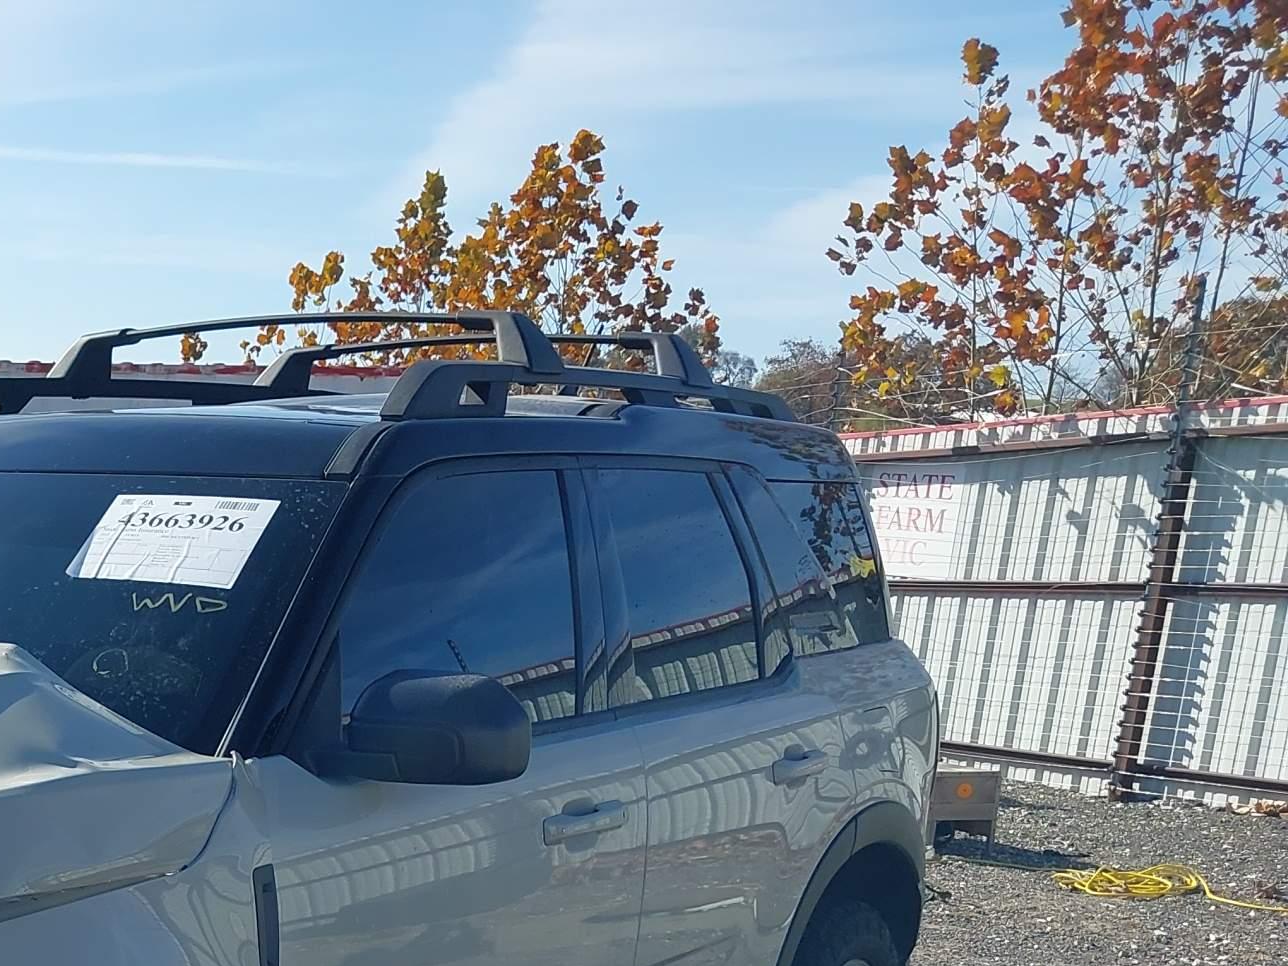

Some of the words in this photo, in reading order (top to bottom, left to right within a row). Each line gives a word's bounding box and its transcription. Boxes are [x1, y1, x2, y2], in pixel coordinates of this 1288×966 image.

[877, 472, 955, 500] STATE
[118, 511, 249, 532] 43663926
[877, 505, 946, 533] FARM
